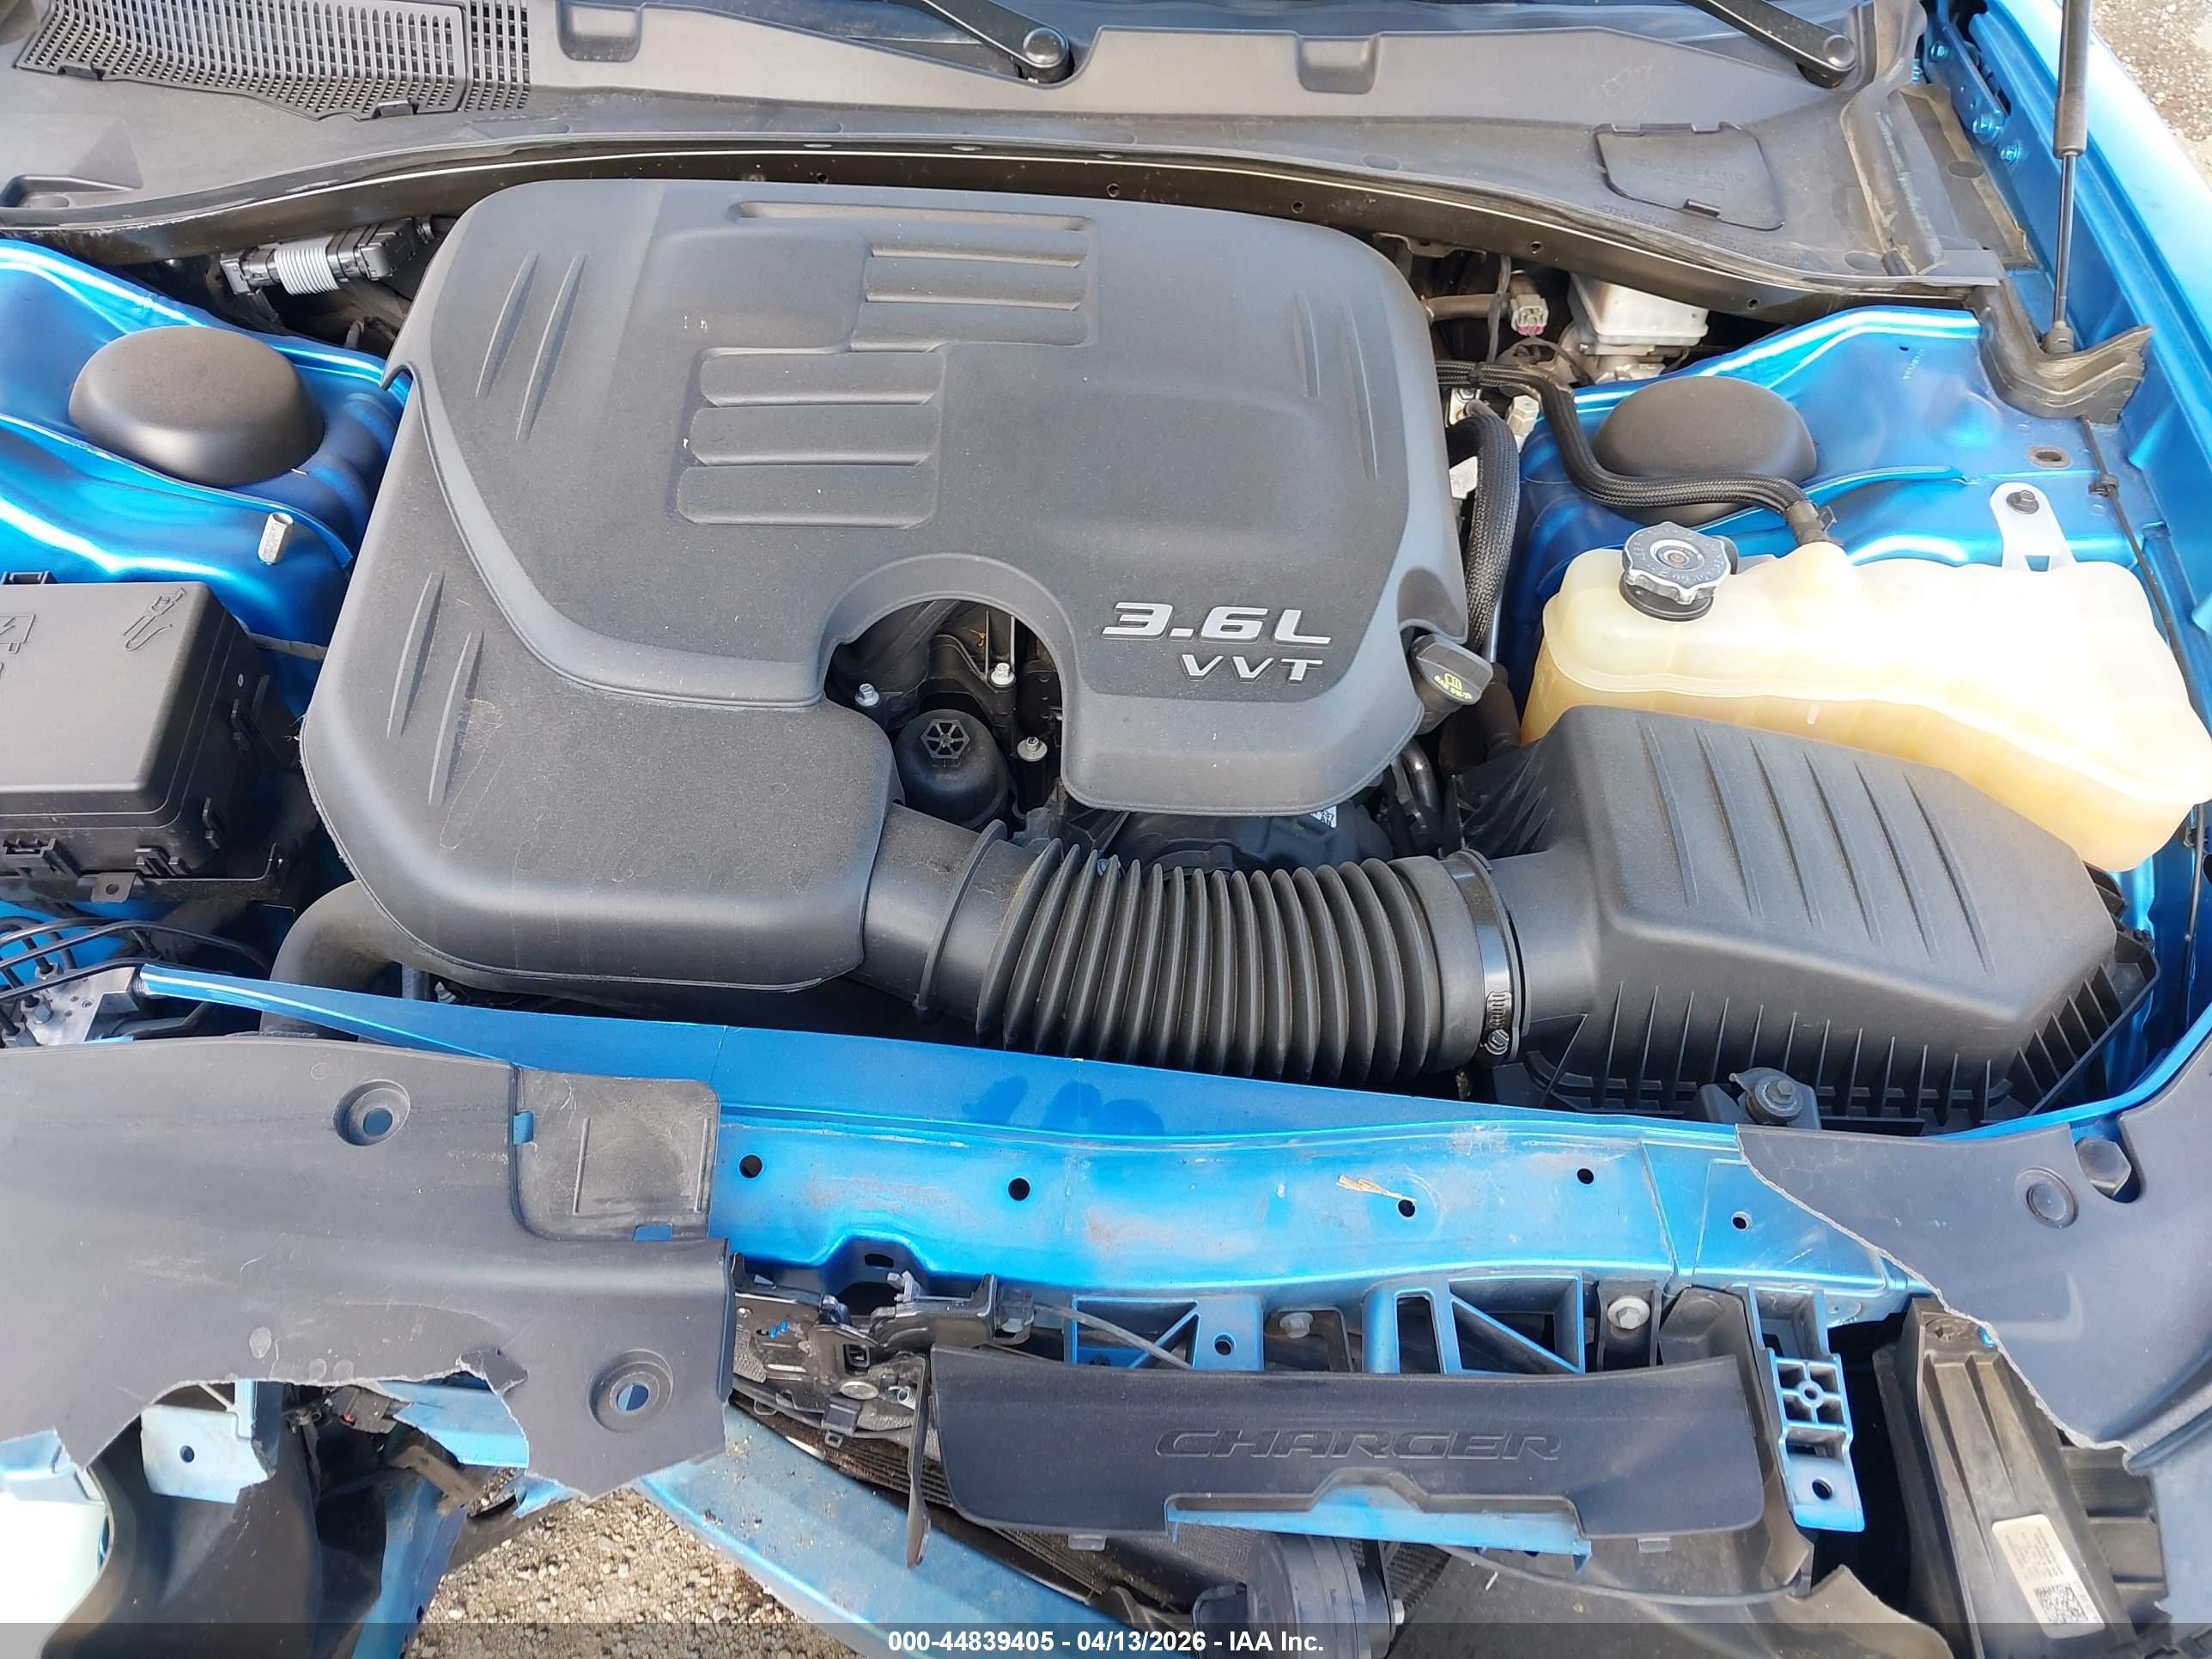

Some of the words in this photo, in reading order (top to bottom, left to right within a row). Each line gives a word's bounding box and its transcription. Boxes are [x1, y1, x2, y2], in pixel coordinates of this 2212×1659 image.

[1102, 602, 1331, 647] 3.6L
[1178, 653, 1324, 684] VVT
[1155, 1429, 1562, 1460] CHARGER
